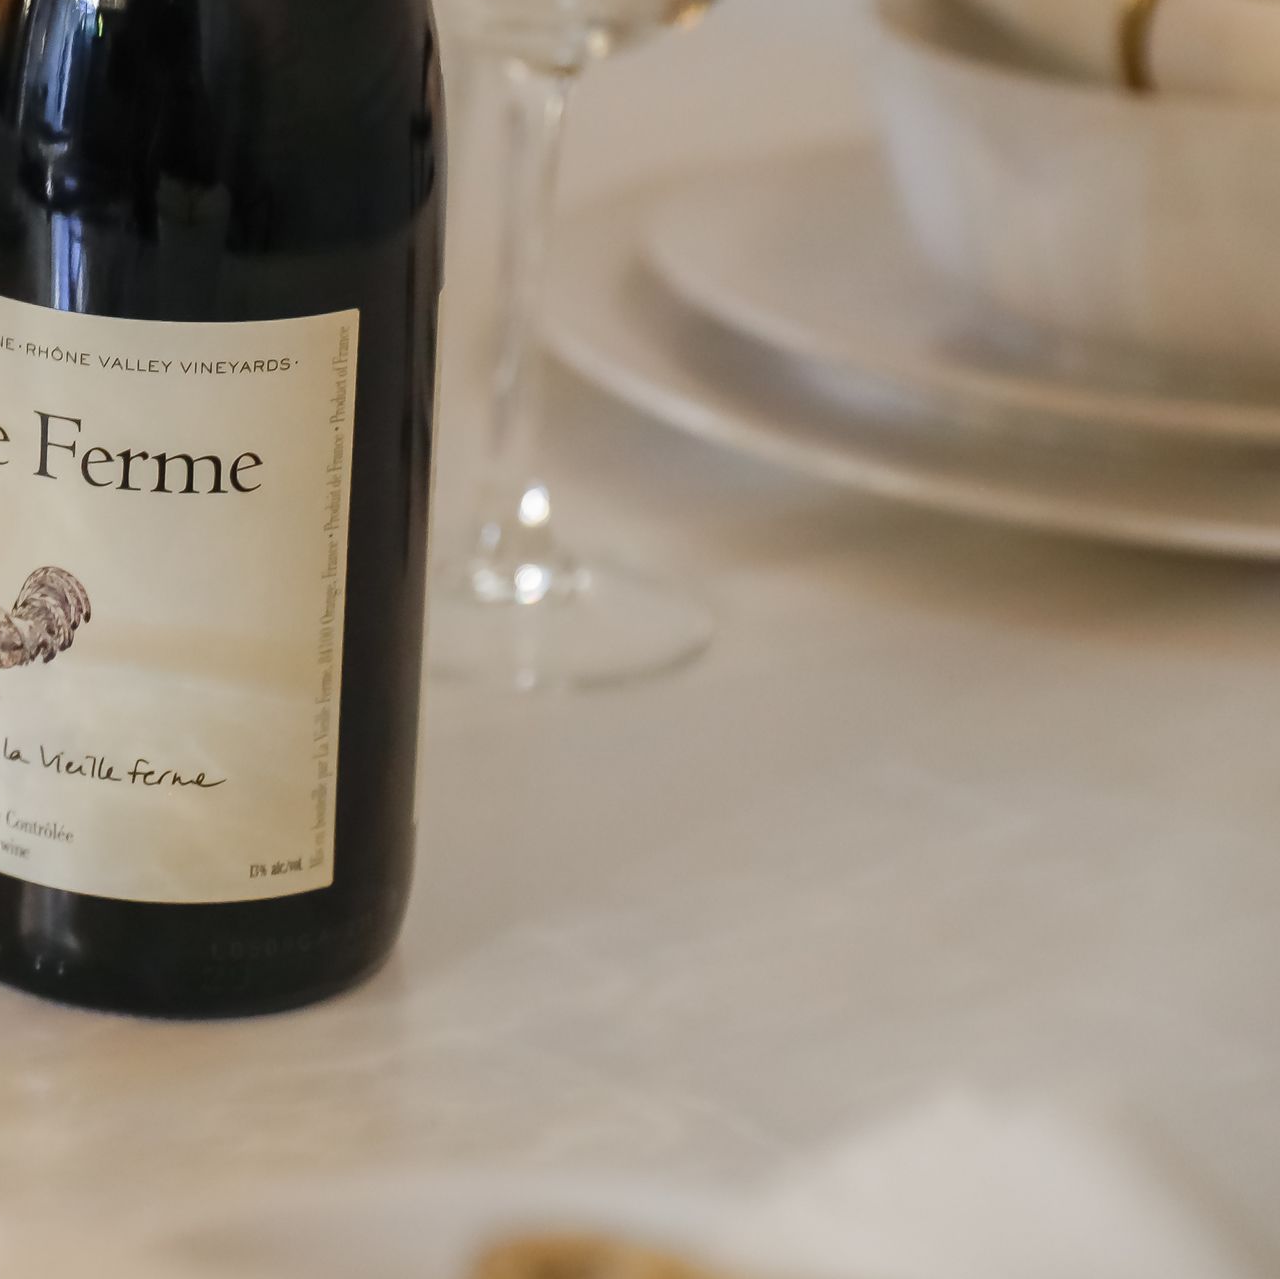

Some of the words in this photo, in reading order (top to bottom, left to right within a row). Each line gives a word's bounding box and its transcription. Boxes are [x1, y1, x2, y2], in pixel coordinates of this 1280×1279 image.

[26, 342, 91, 367] RHÔNE
[98, 355, 172, 373] VALLEY
[180, 357, 292, 375] VINEYARDS
[33, 410, 264, 495] Ferme
[3, 737, 31, 764] la
[40, 745, 122, 783] Vieille
[128, 758, 227, 789] ferme
[6, 809, 75, 844] Contrôlée
